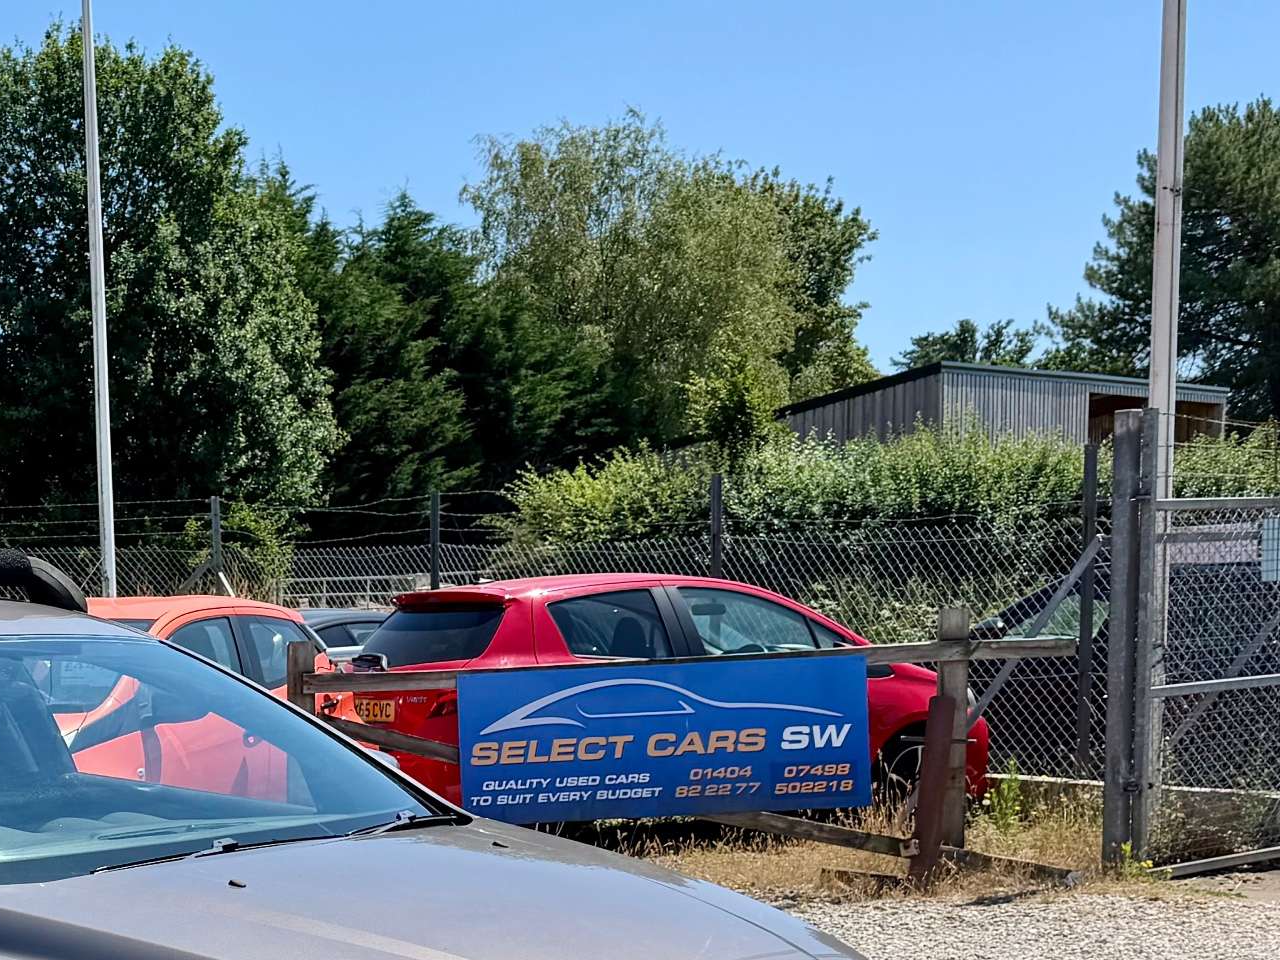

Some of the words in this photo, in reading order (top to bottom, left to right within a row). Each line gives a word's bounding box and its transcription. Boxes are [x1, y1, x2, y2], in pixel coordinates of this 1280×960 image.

[470, 734, 634, 766] SELECT
[647, 728, 766, 758] CARS
[780, 723, 851, 751] SW
[689, 766, 752, 780] 01404
[784, 763, 851, 778] 07498
[482, 777, 551, 791] QUALITY
[555, 775, 601, 789] USED
[605, 773, 650, 787] CARS
[774, 780, 853, 794] 502218
[471, 795, 493, 806] TO
[496, 793, 534, 805] SUIT
[537, 791, 593, 804] EVERY
[596, 787, 662, 801] BUDGET
